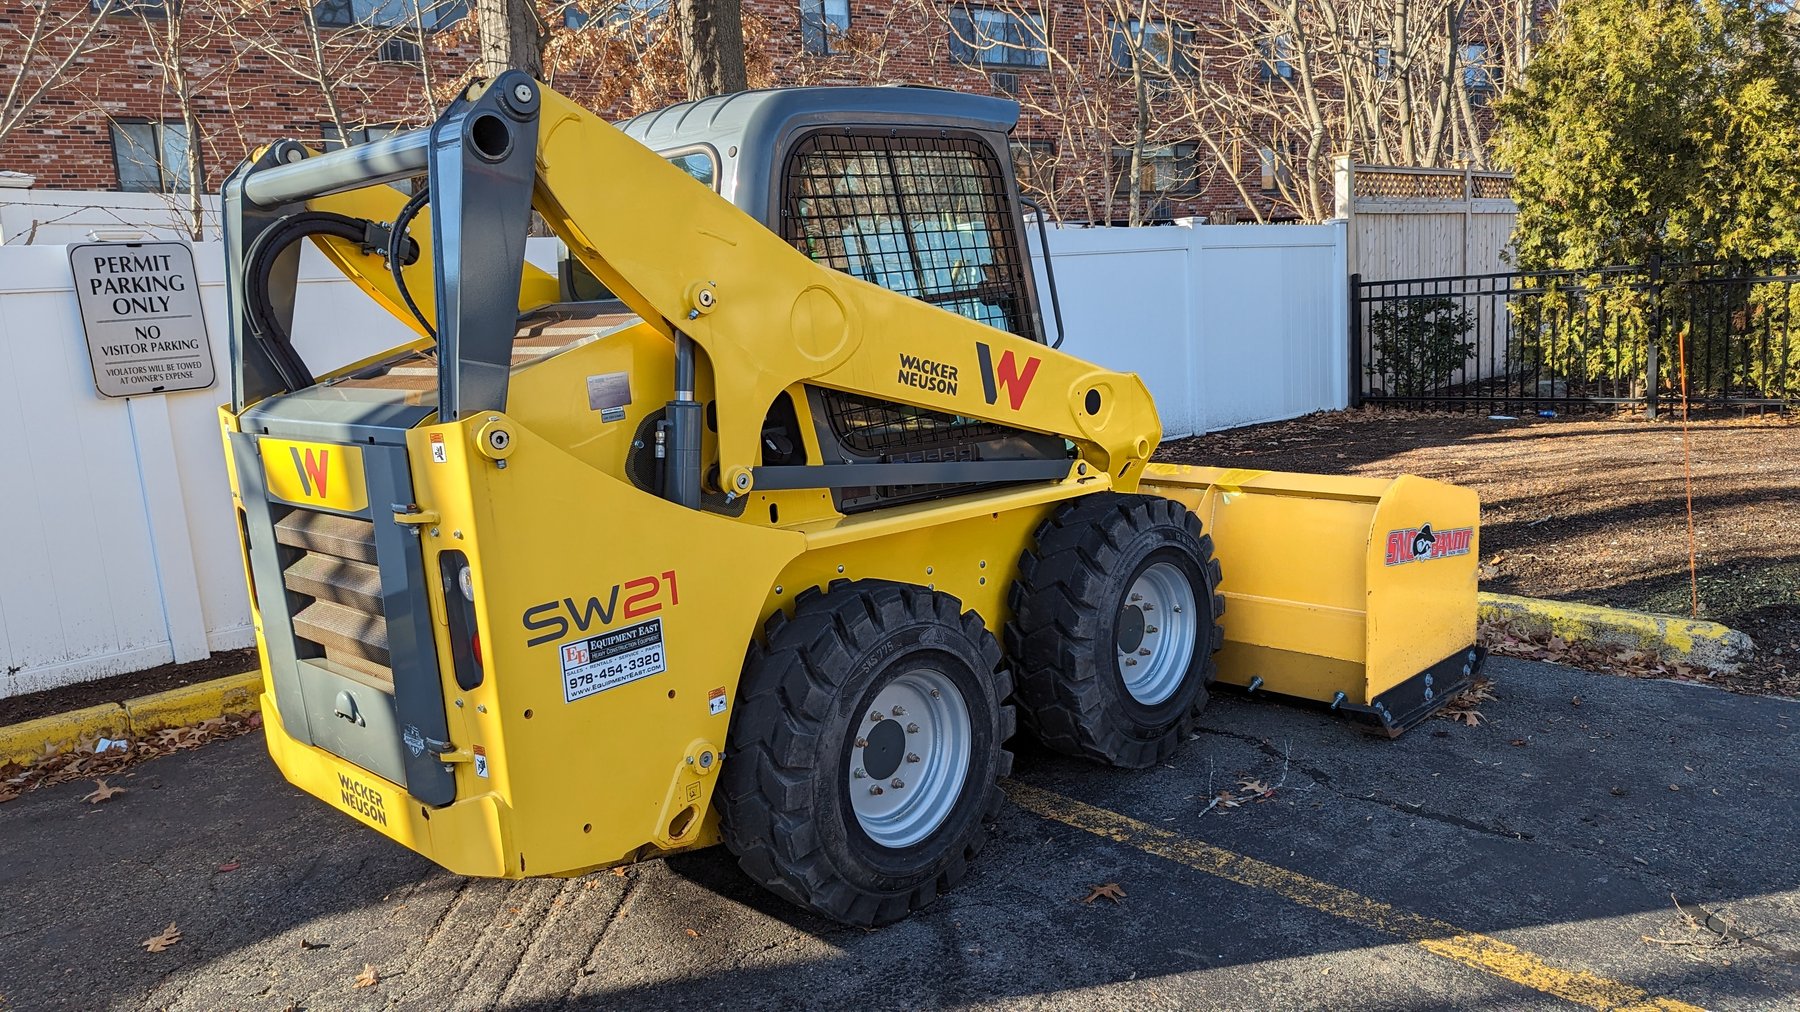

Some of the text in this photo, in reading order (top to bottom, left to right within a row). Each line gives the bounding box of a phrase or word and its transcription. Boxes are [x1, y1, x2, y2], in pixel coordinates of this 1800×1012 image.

[94, 255, 171, 274] PERMIT
[90, 274, 185, 295] PARKING
[113, 296, 170, 315] ONLY
[135, 325, 161, 340] NO
[101, 339, 199, 356] VISITOR PARKING
[106, 361, 202, 377] VIOLATORS WILL BE TOWED
[120, 371, 194, 385] AT OWNER'S EXPENSE
[899, 353, 958, 381] WACKER
[897, 369, 958, 396] NEUSON
[522, 569, 679, 648] SW21
[590, 623, 659, 651] EQUIPMENT EAST
[566, 645, 661, 676] SALES RENTALS SERVICE PARTS
[569, 652, 660, 689] 978-454-3320
[337, 771, 384, 809] WACKER
[341, 788, 387, 827] NEUSON
